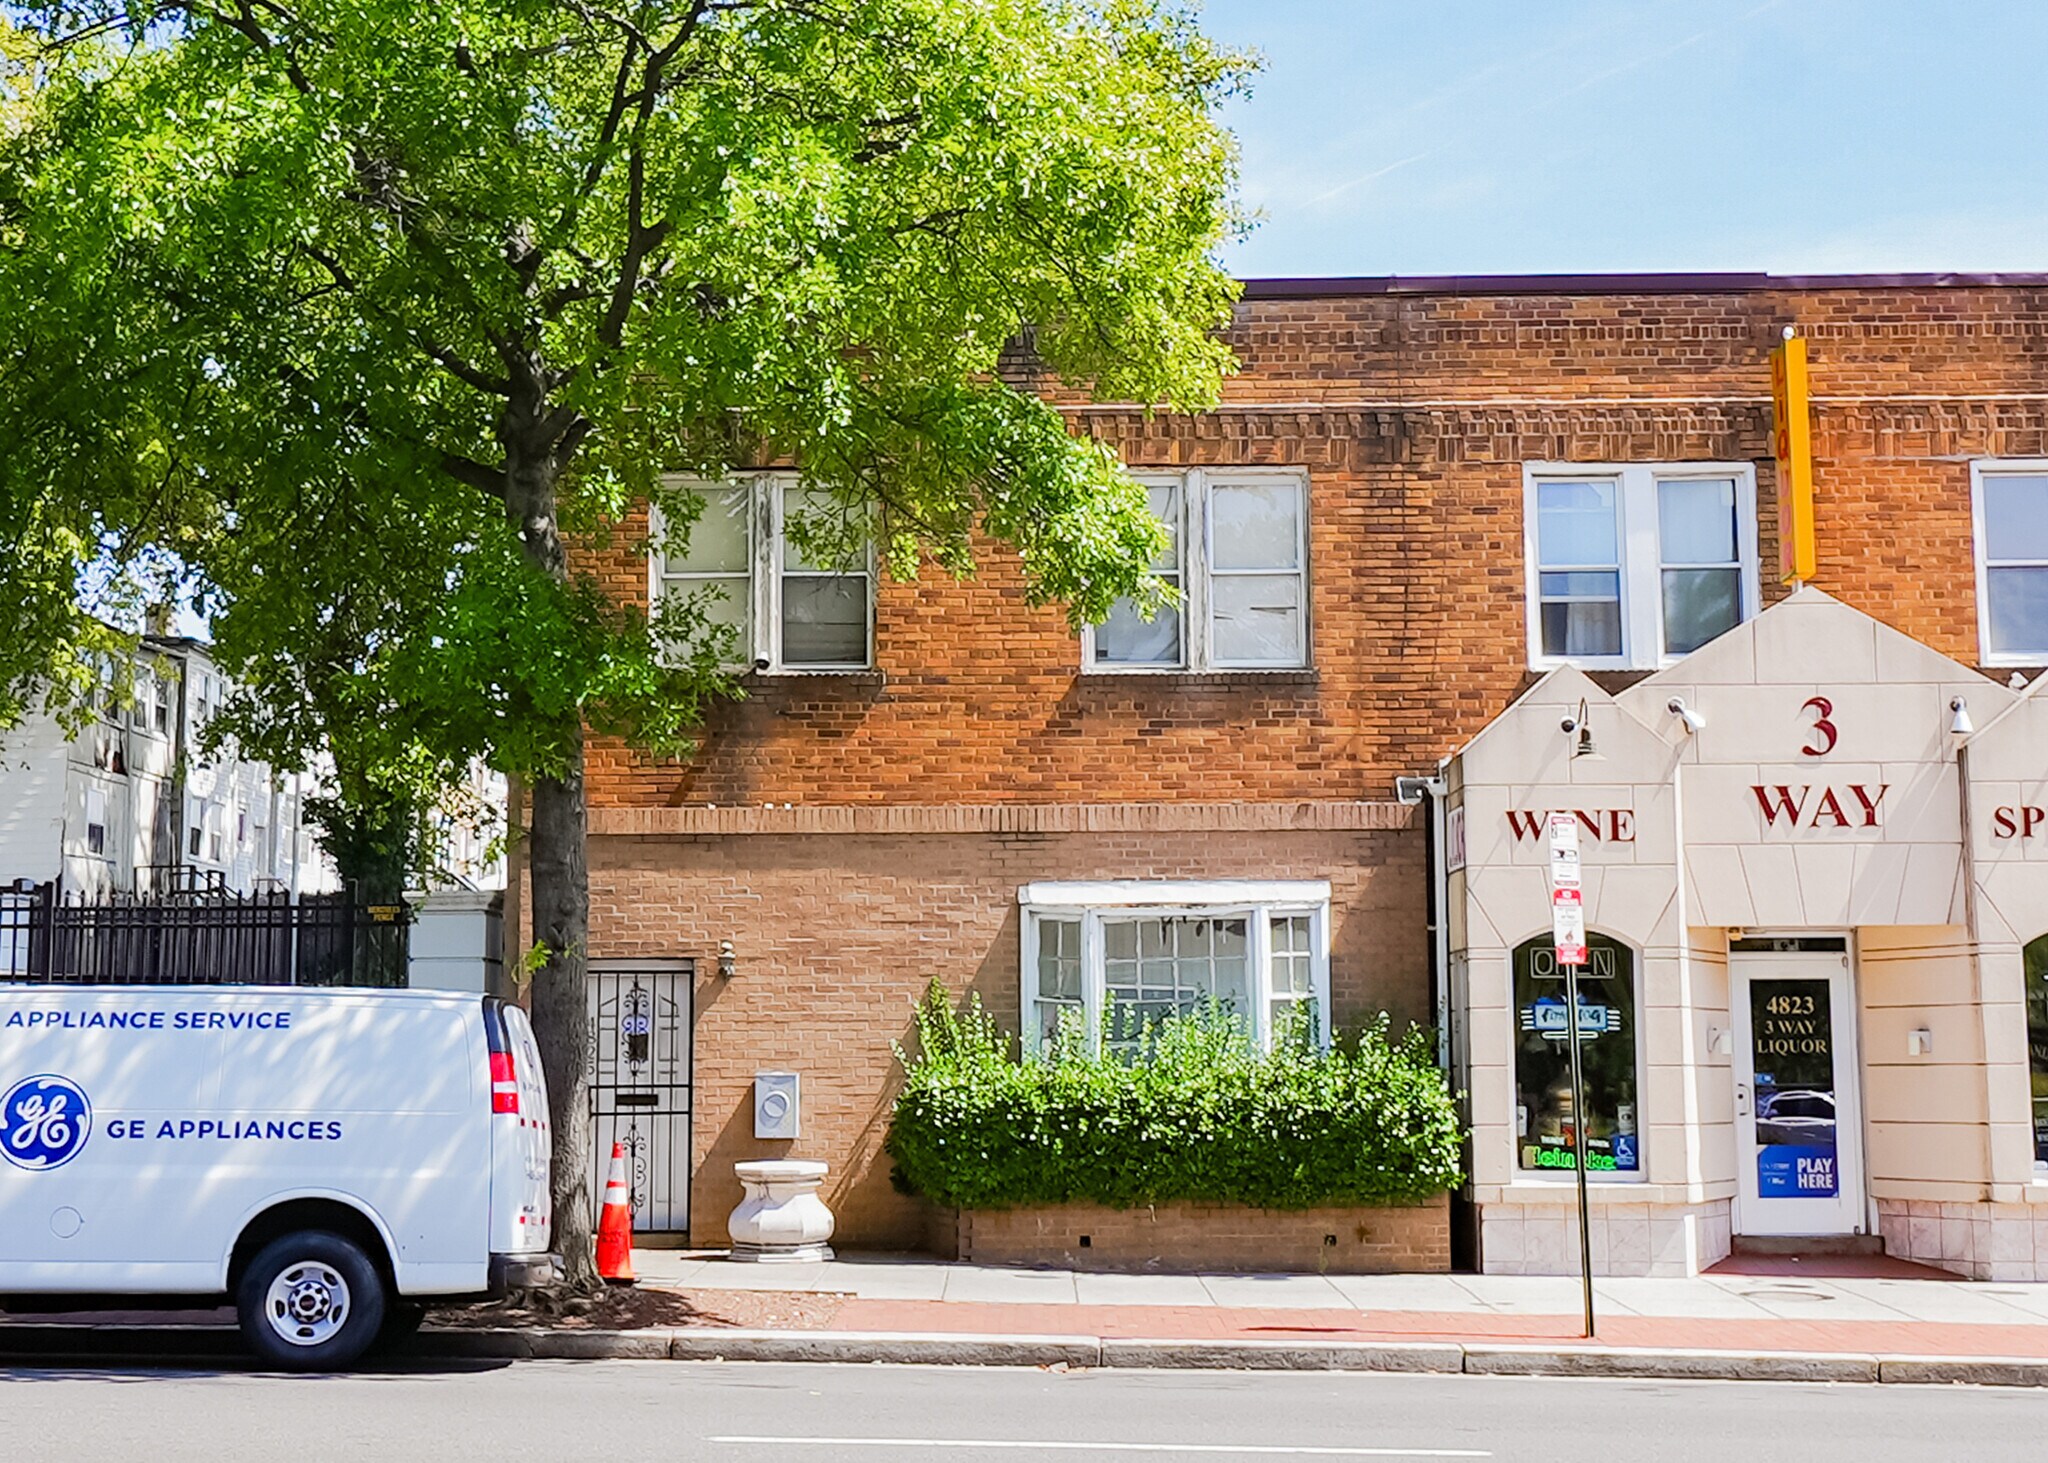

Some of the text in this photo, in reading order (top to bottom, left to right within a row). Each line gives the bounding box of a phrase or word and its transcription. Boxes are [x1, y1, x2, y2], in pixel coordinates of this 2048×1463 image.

[1800, 696, 1837, 756] 3
[1750, 784, 1890, 828] WAY
[1505, 809, 1636, 842] WNE
[1766, 996, 1815, 1015] 4823
[5, 1011, 291, 1029] APPLIANCE SERVICE
[1765, 1020, 1816, 1034] 3 WAY
[1757, 1039, 1828, 1056] LIQUOR
[107, 1120, 342, 1140] GE APPLIANCES
[1797, 1158, 1832, 1173] PLAY
[1798, 1173, 1834, 1189] HERE
